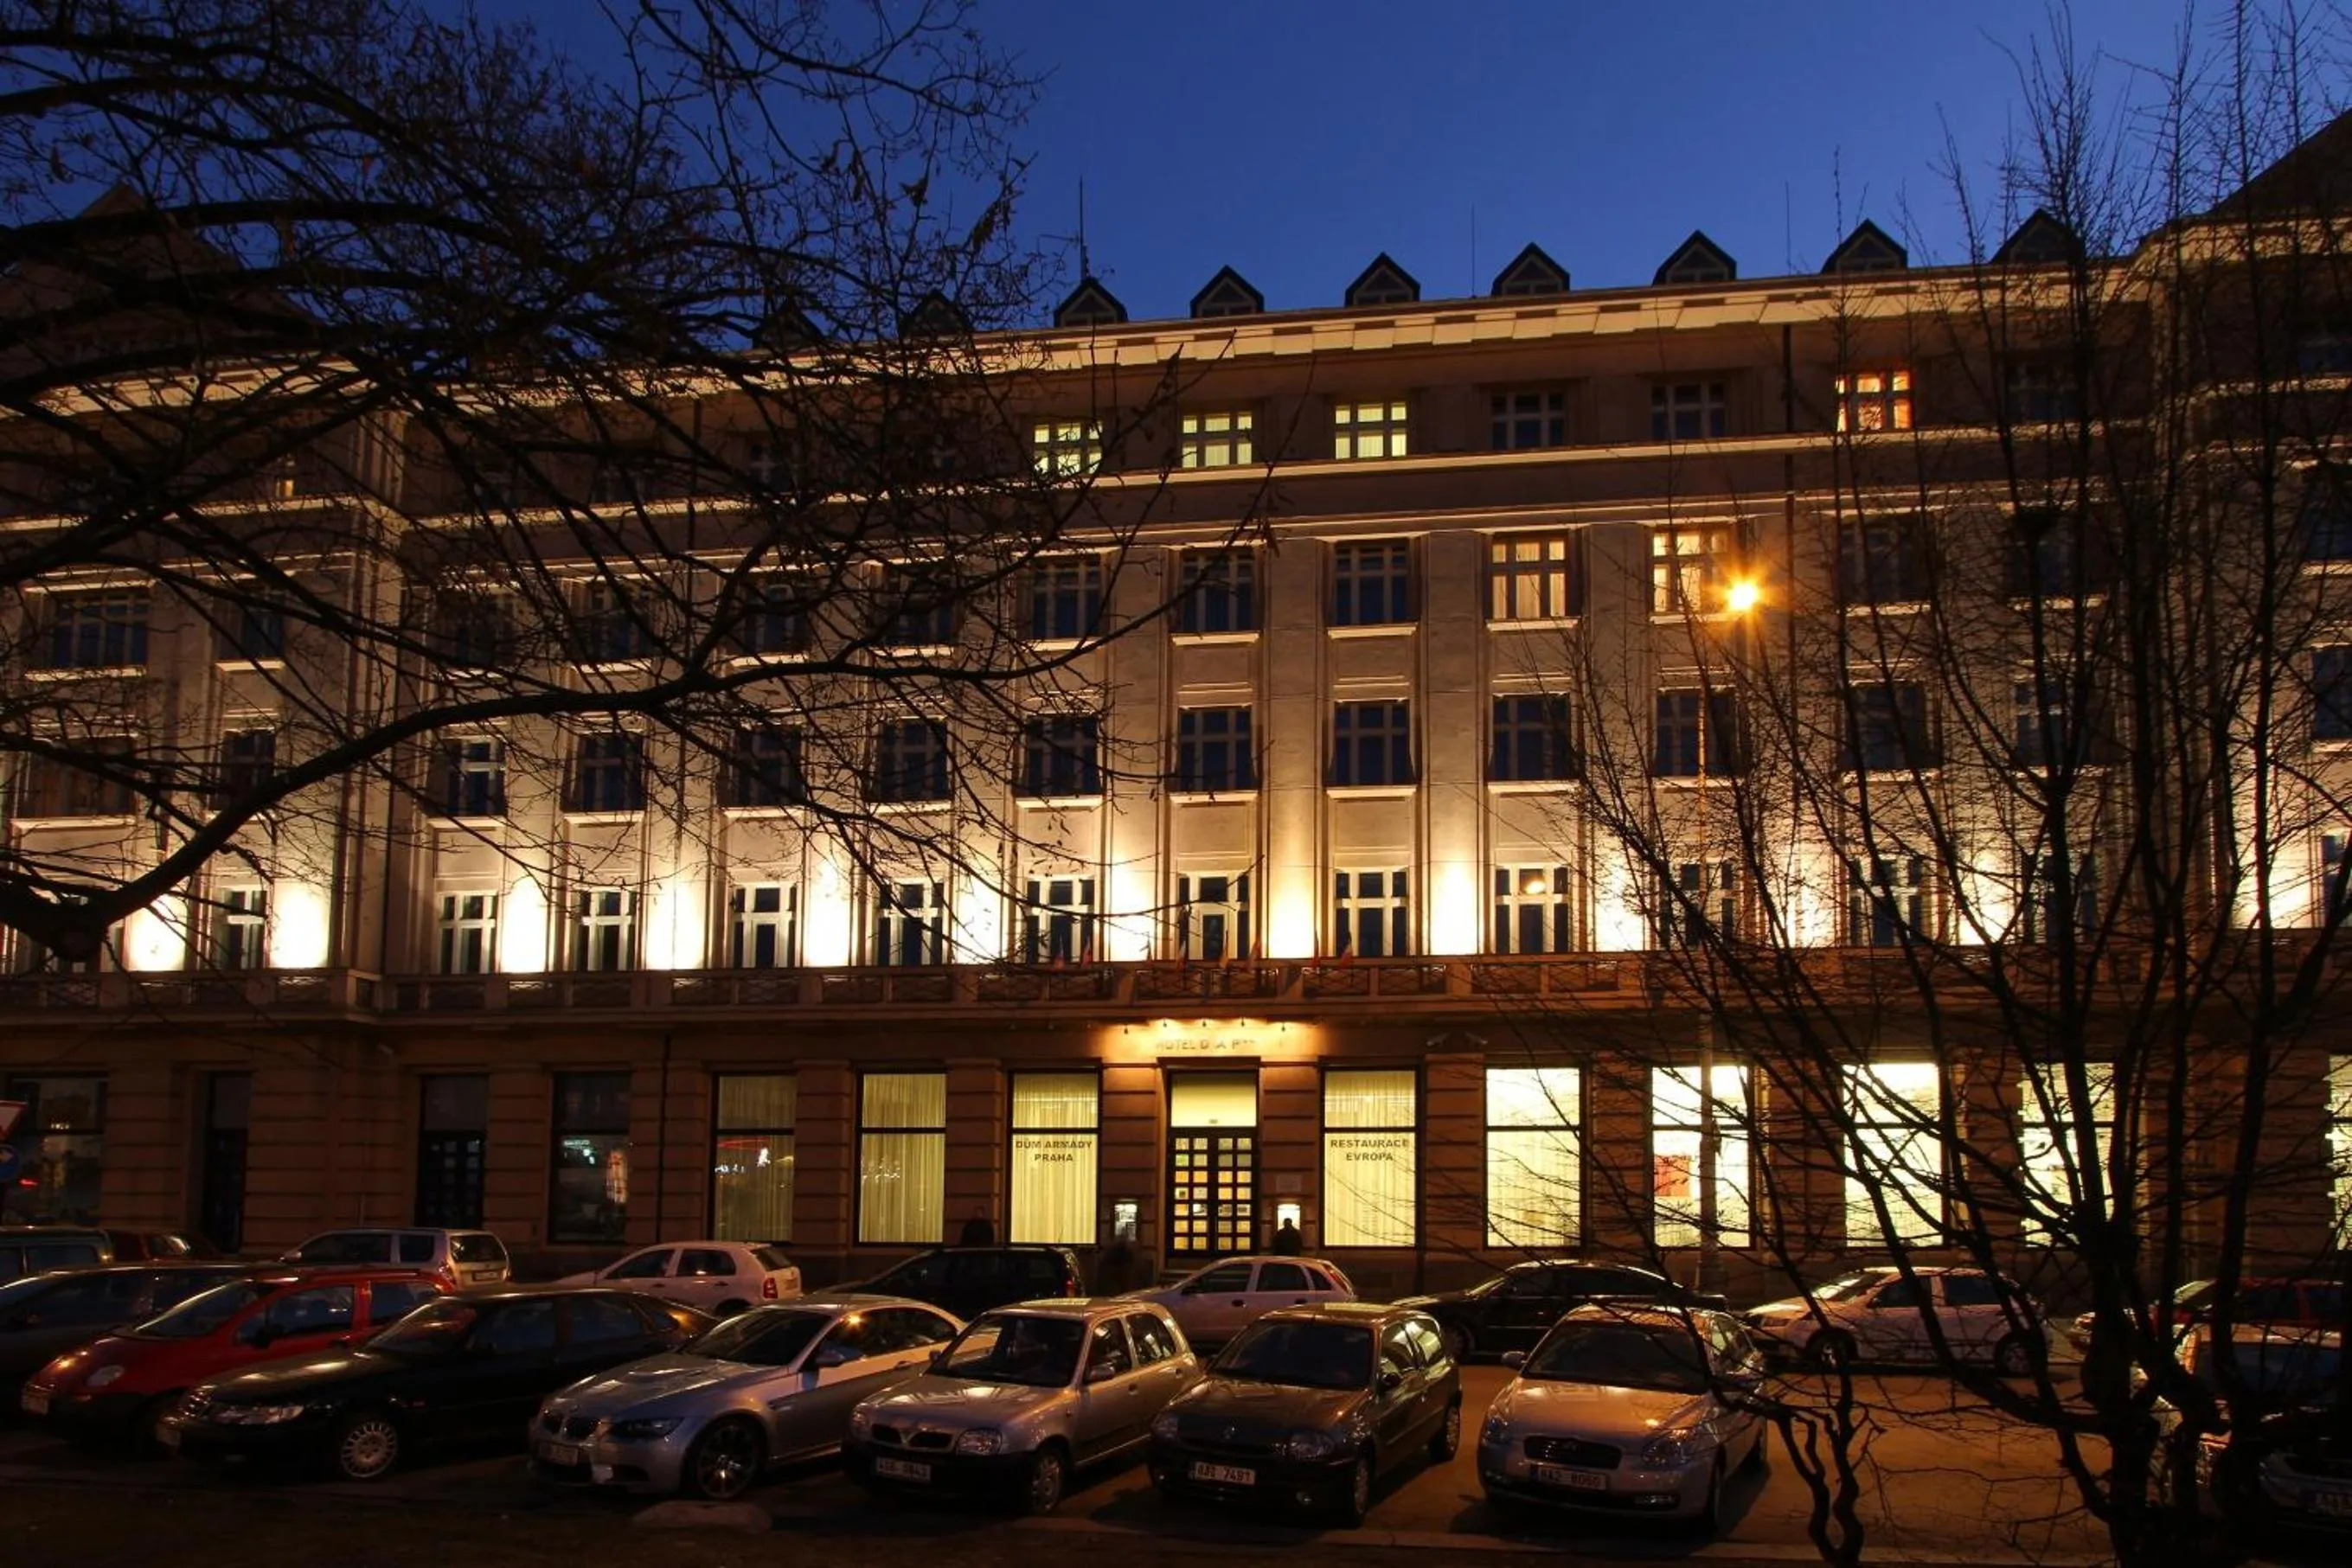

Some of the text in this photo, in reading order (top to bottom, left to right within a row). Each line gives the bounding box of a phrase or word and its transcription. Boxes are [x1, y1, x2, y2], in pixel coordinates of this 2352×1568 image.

[1330, 1139, 1409, 1149] RESTAURACE
[1034, 1153, 1073, 1162] PRAHA
[1346, 1152, 1394, 1162] EVROPA
